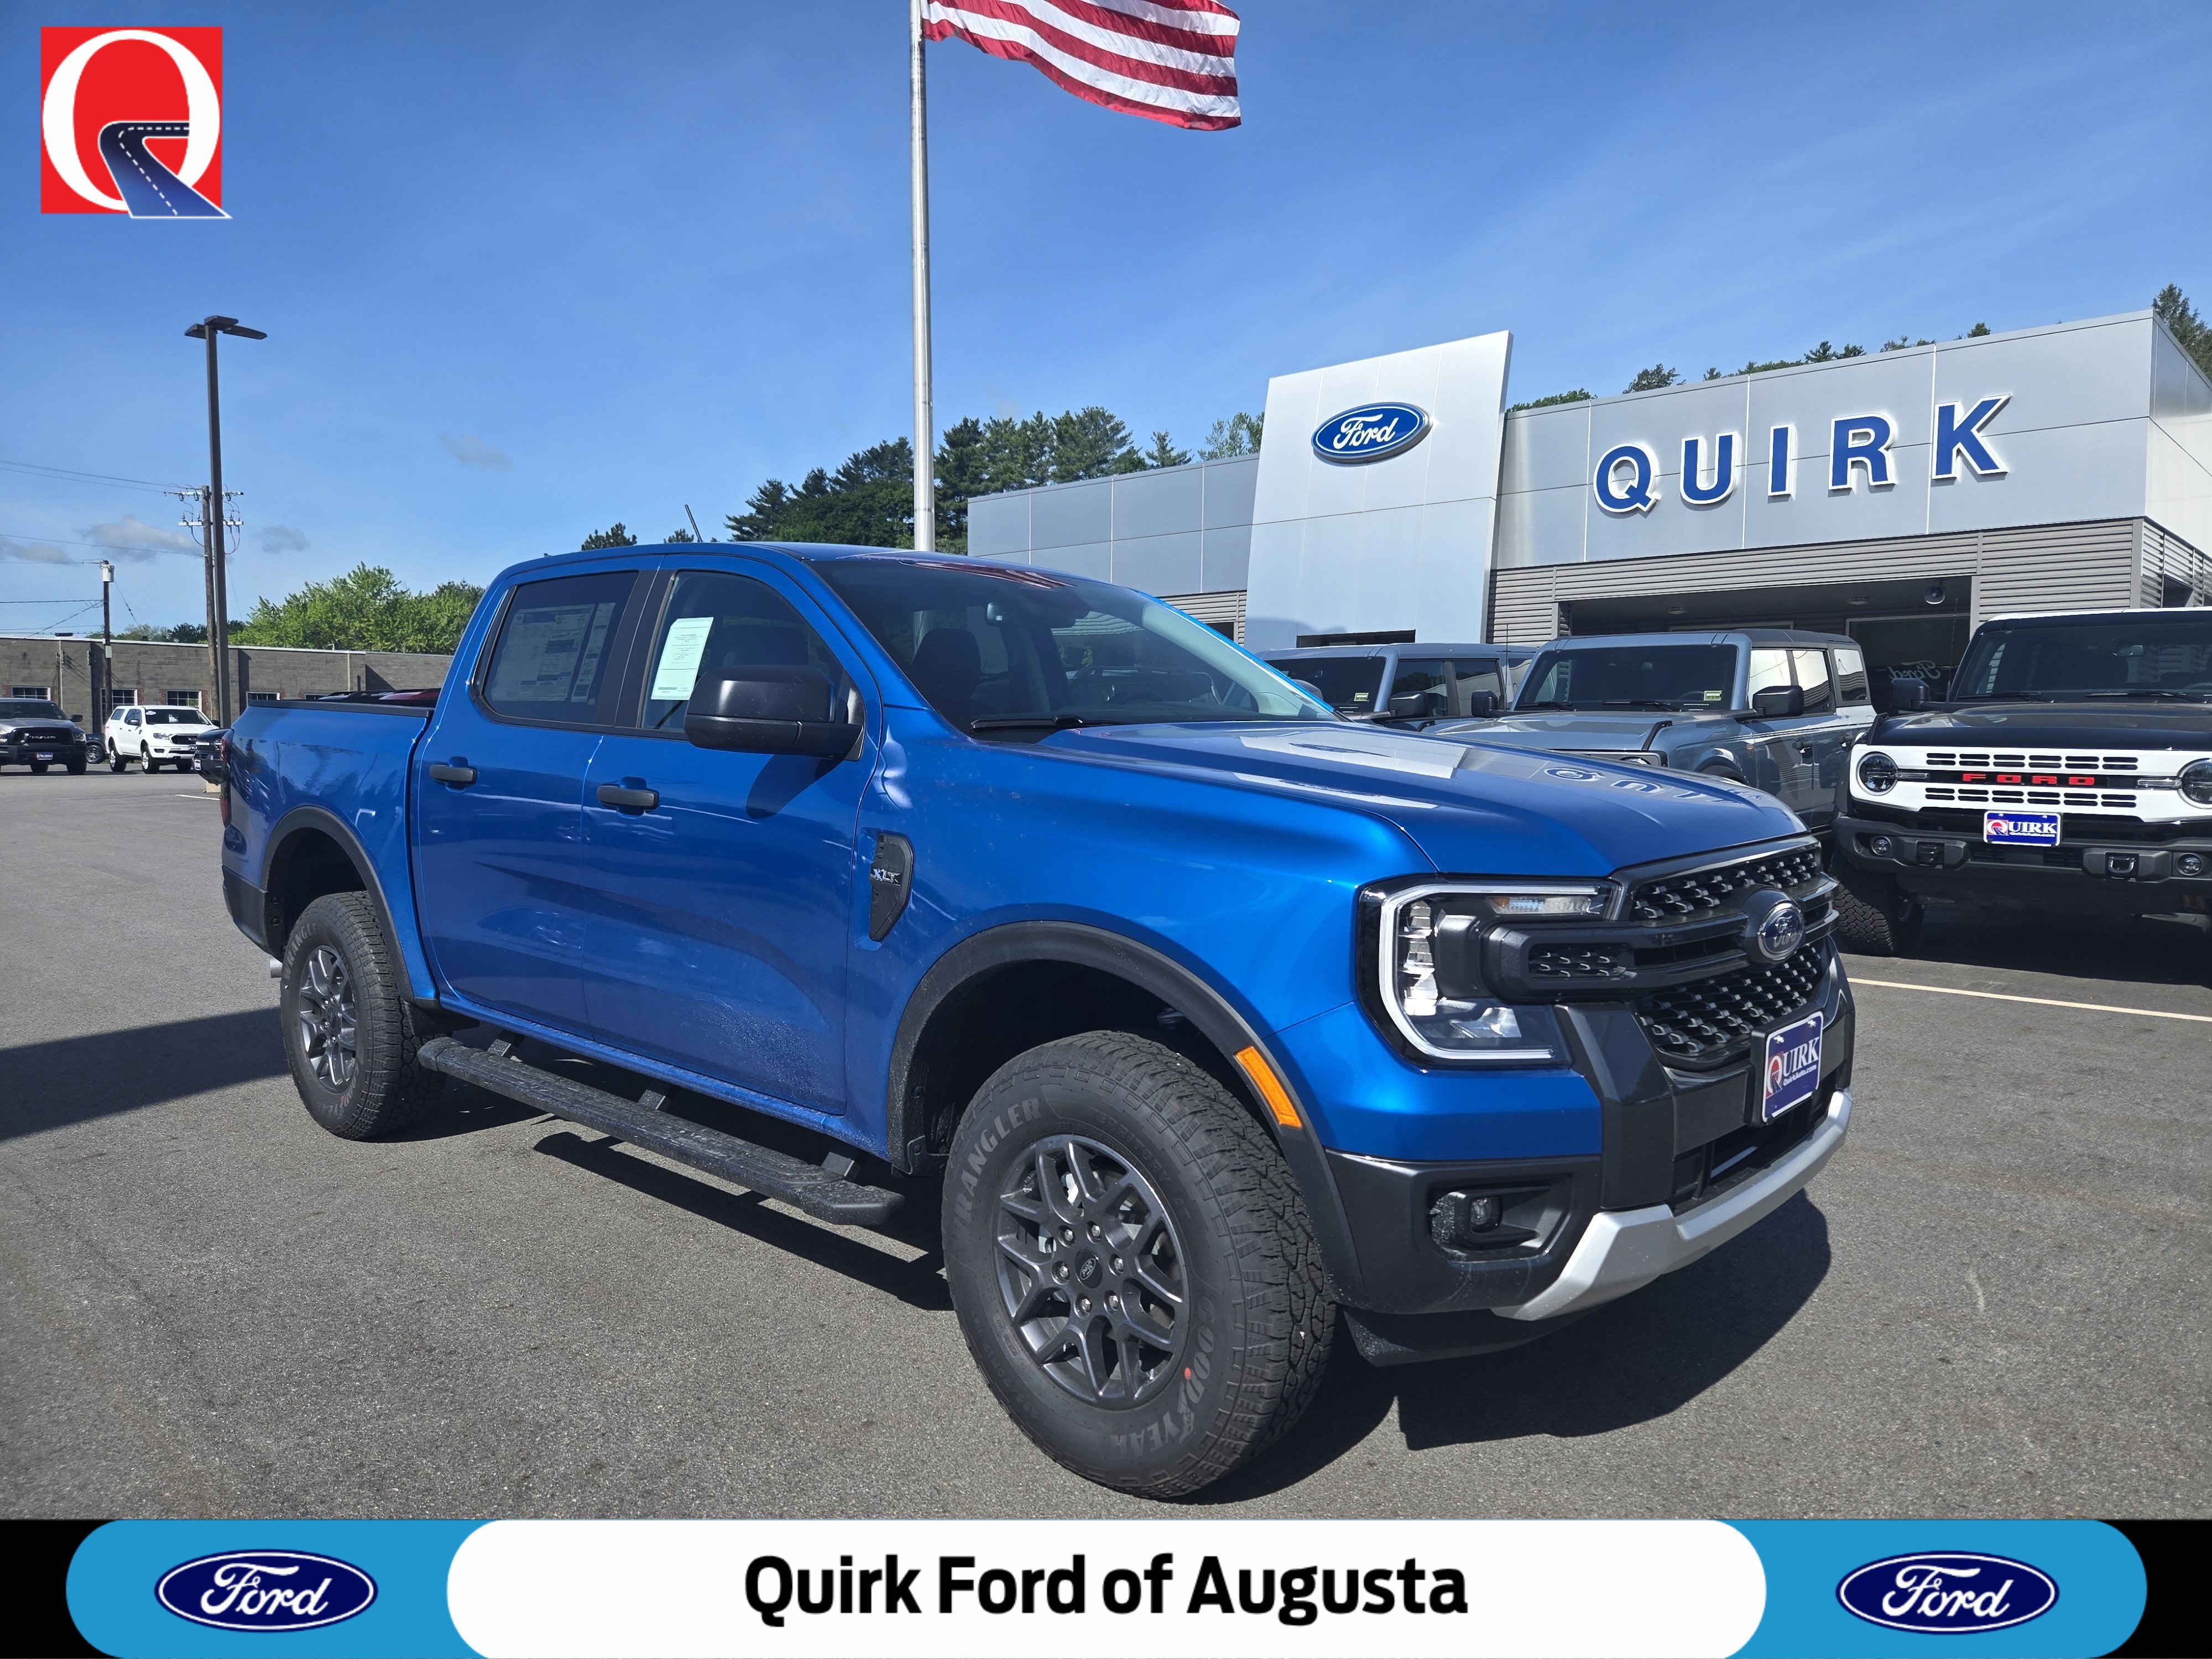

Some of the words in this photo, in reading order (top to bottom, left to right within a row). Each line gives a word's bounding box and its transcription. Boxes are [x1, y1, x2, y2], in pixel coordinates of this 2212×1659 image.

[1333, 414, 1399, 449] Ford
[1593, 394, 2010, 512] QUIRK
[1963, 773, 2095, 786] FORD
[1986, 820, 2058, 836] QUIRK
[871, 868, 901, 884] XLT
[1767, 1036, 1820, 1094] QUIRK
[1783, 1064, 1817, 1087] QuirkAuto.com
[952, 1097, 1043, 1253] WRANGLER
[1108, 1295, 1215, 1460] GOODYEAR
